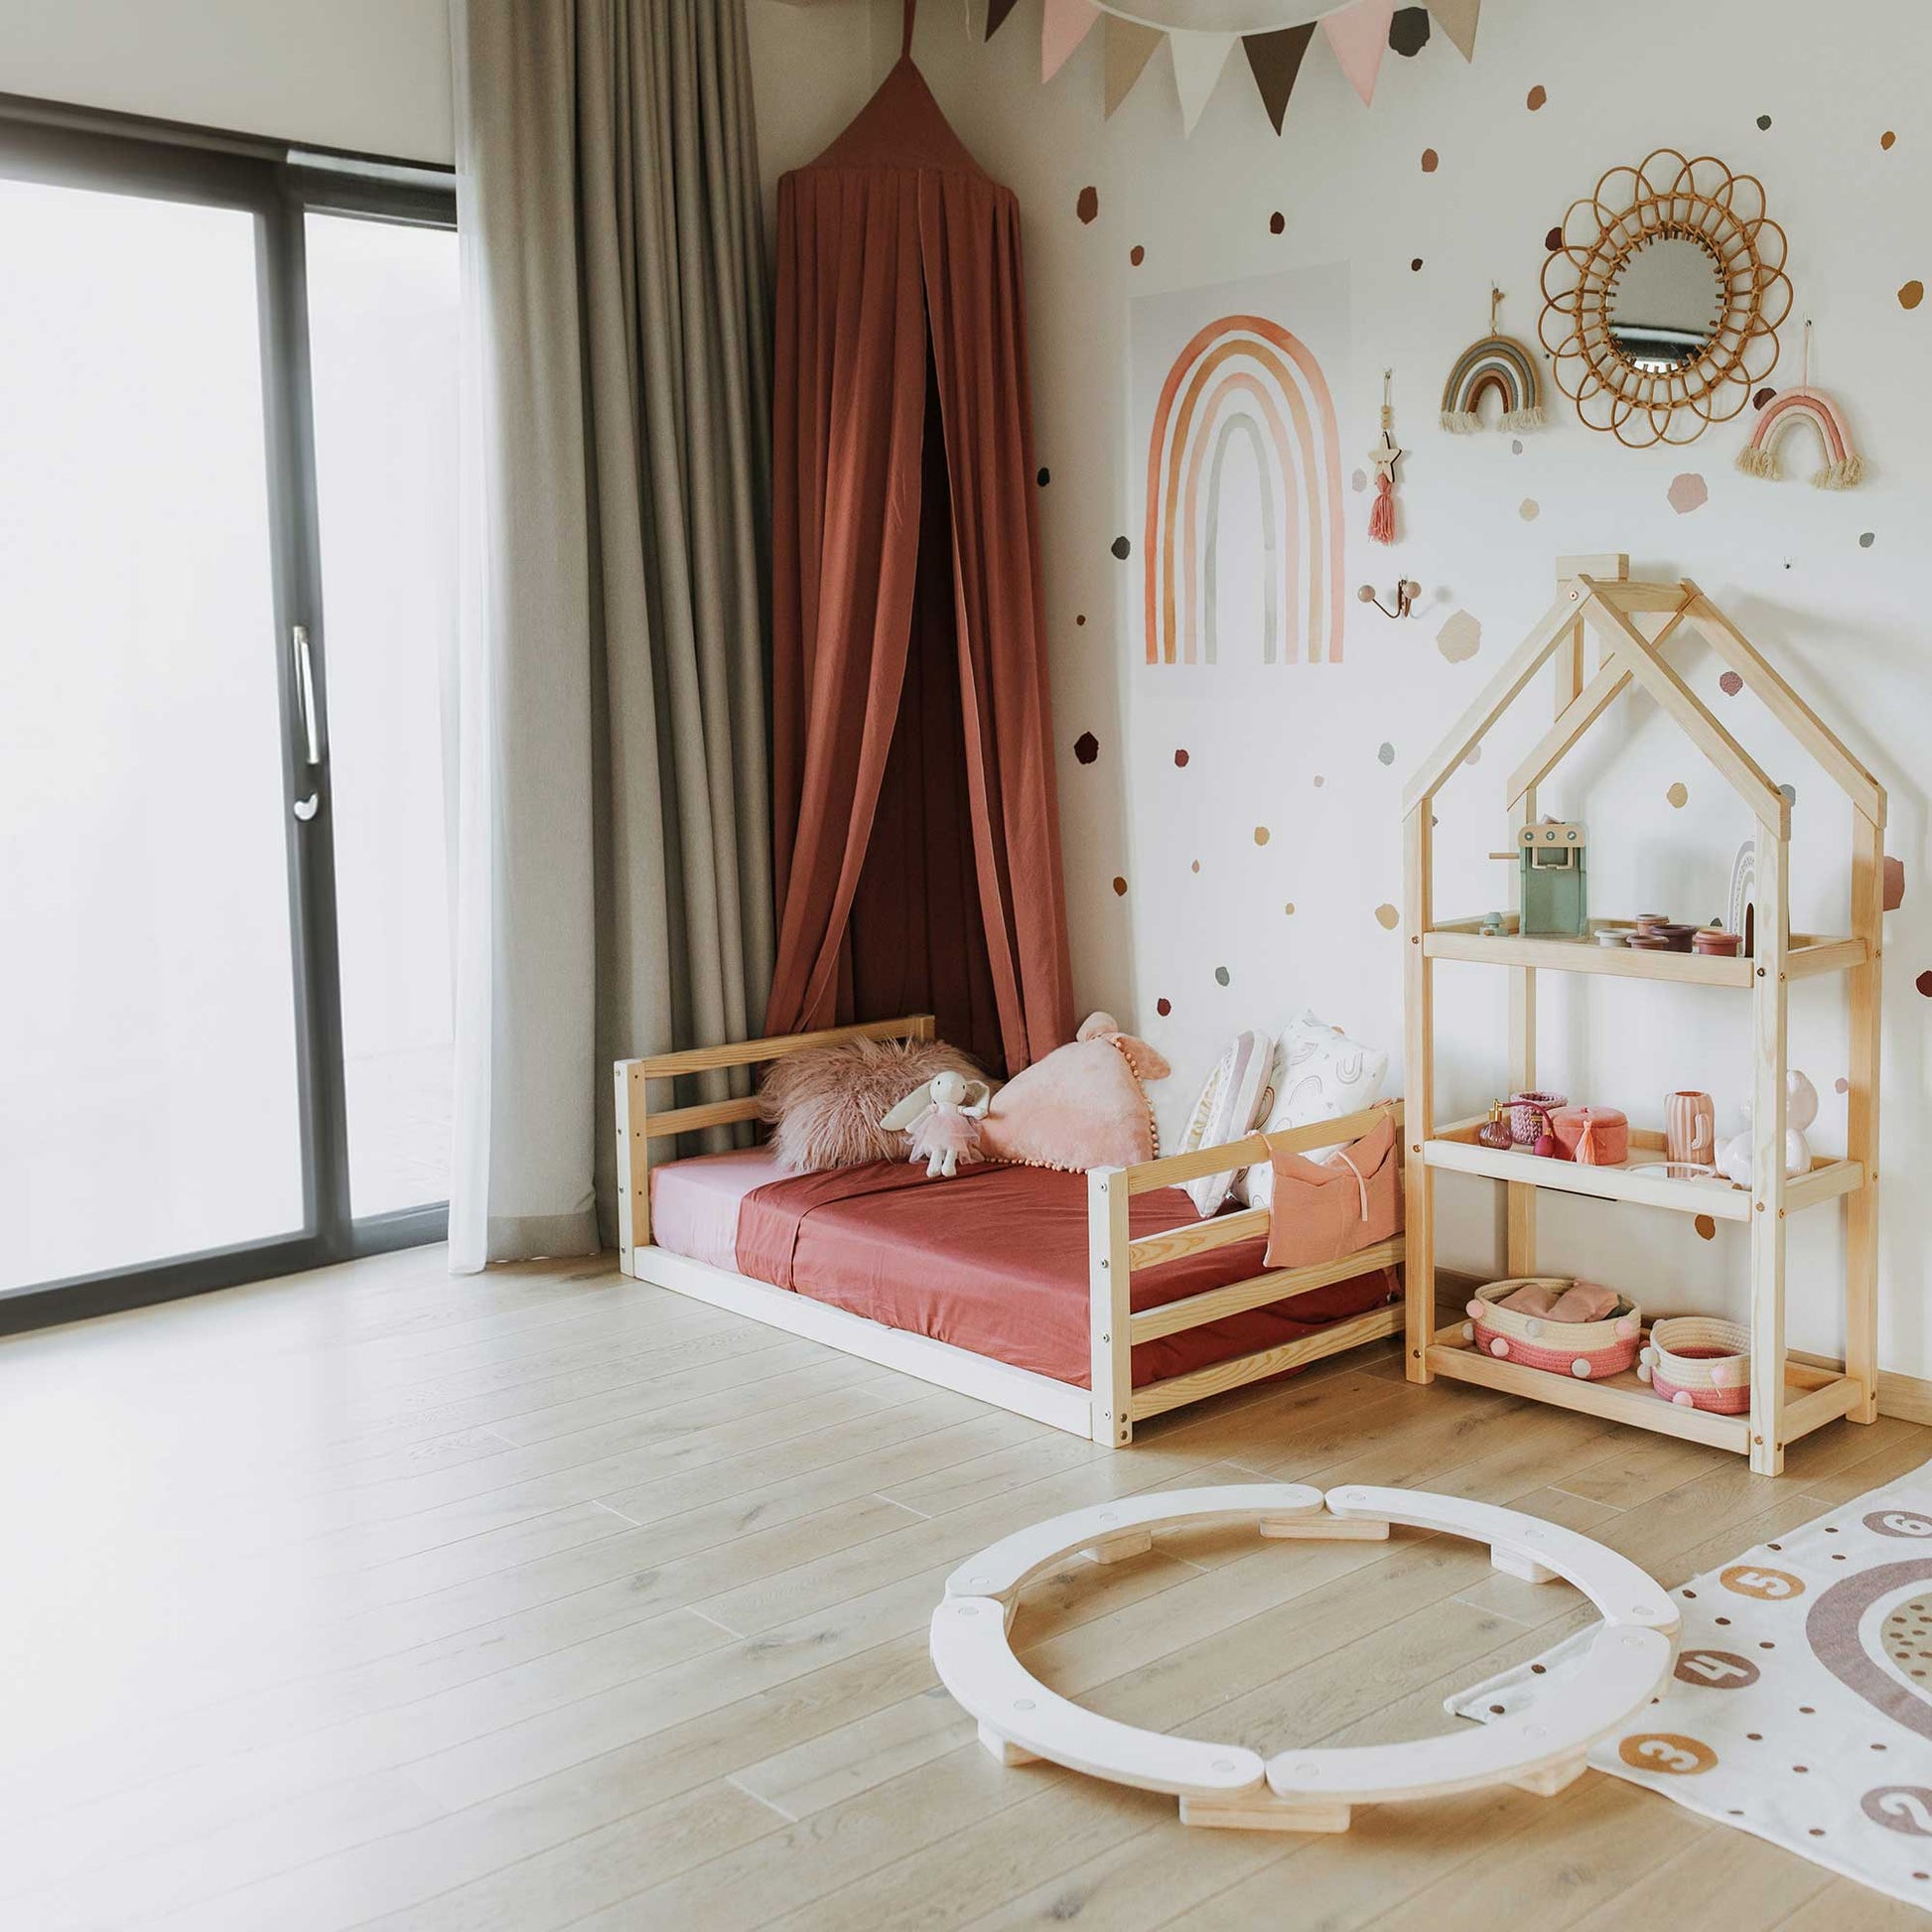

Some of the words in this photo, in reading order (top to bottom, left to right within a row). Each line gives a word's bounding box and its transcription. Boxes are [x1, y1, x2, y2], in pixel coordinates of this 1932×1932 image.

[1883, 1514, 1932, 1536] 6
[1735, 1572, 1791, 1595] 5
[1684, 1655, 1748, 1680] 4
[1639, 1740, 1699, 1771] 3
[1879, 1793, 1932, 1832] 2
